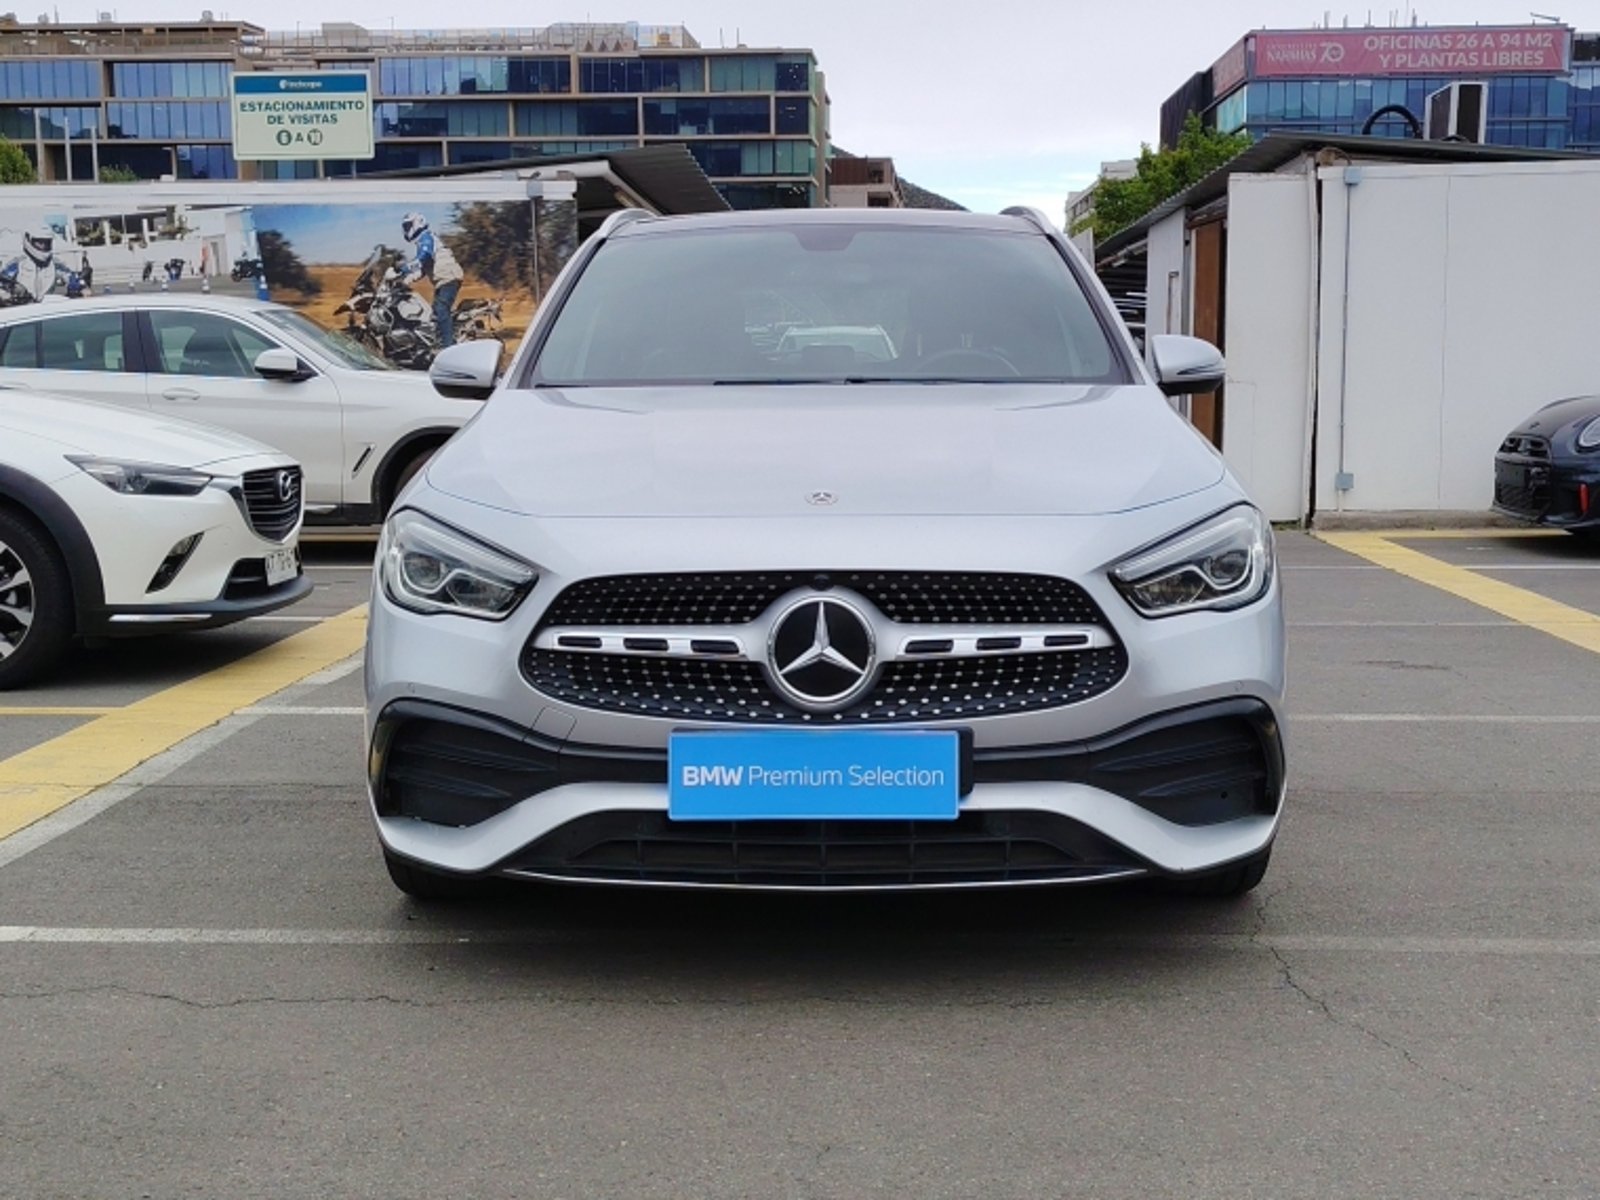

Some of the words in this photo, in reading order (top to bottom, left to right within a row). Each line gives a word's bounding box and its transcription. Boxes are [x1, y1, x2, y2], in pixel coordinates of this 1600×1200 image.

[1364, 34, 1451, 51] OFICINAS
[1456, 33, 1478, 49] 26
[1482, 33, 1495, 48] A
[1500, 33, 1521, 48] 94
[1525, 32, 1553, 48] M2
[1379, 54, 1392, 68] Y
[1395, 52, 1479, 68] PLANTAS
[1482, 51, 1544, 66] LIBRES
[239, 100, 365, 112] ESTACIONAMIENTO
[267, 115, 285, 125] DE
[288, 114, 338, 124] VISITAS
[295, 132, 304, 142] A
[682, 766, 743, 786] BMW
[749, 766, 842, 786] Premium
[848, 765, 944, 786] Selection
